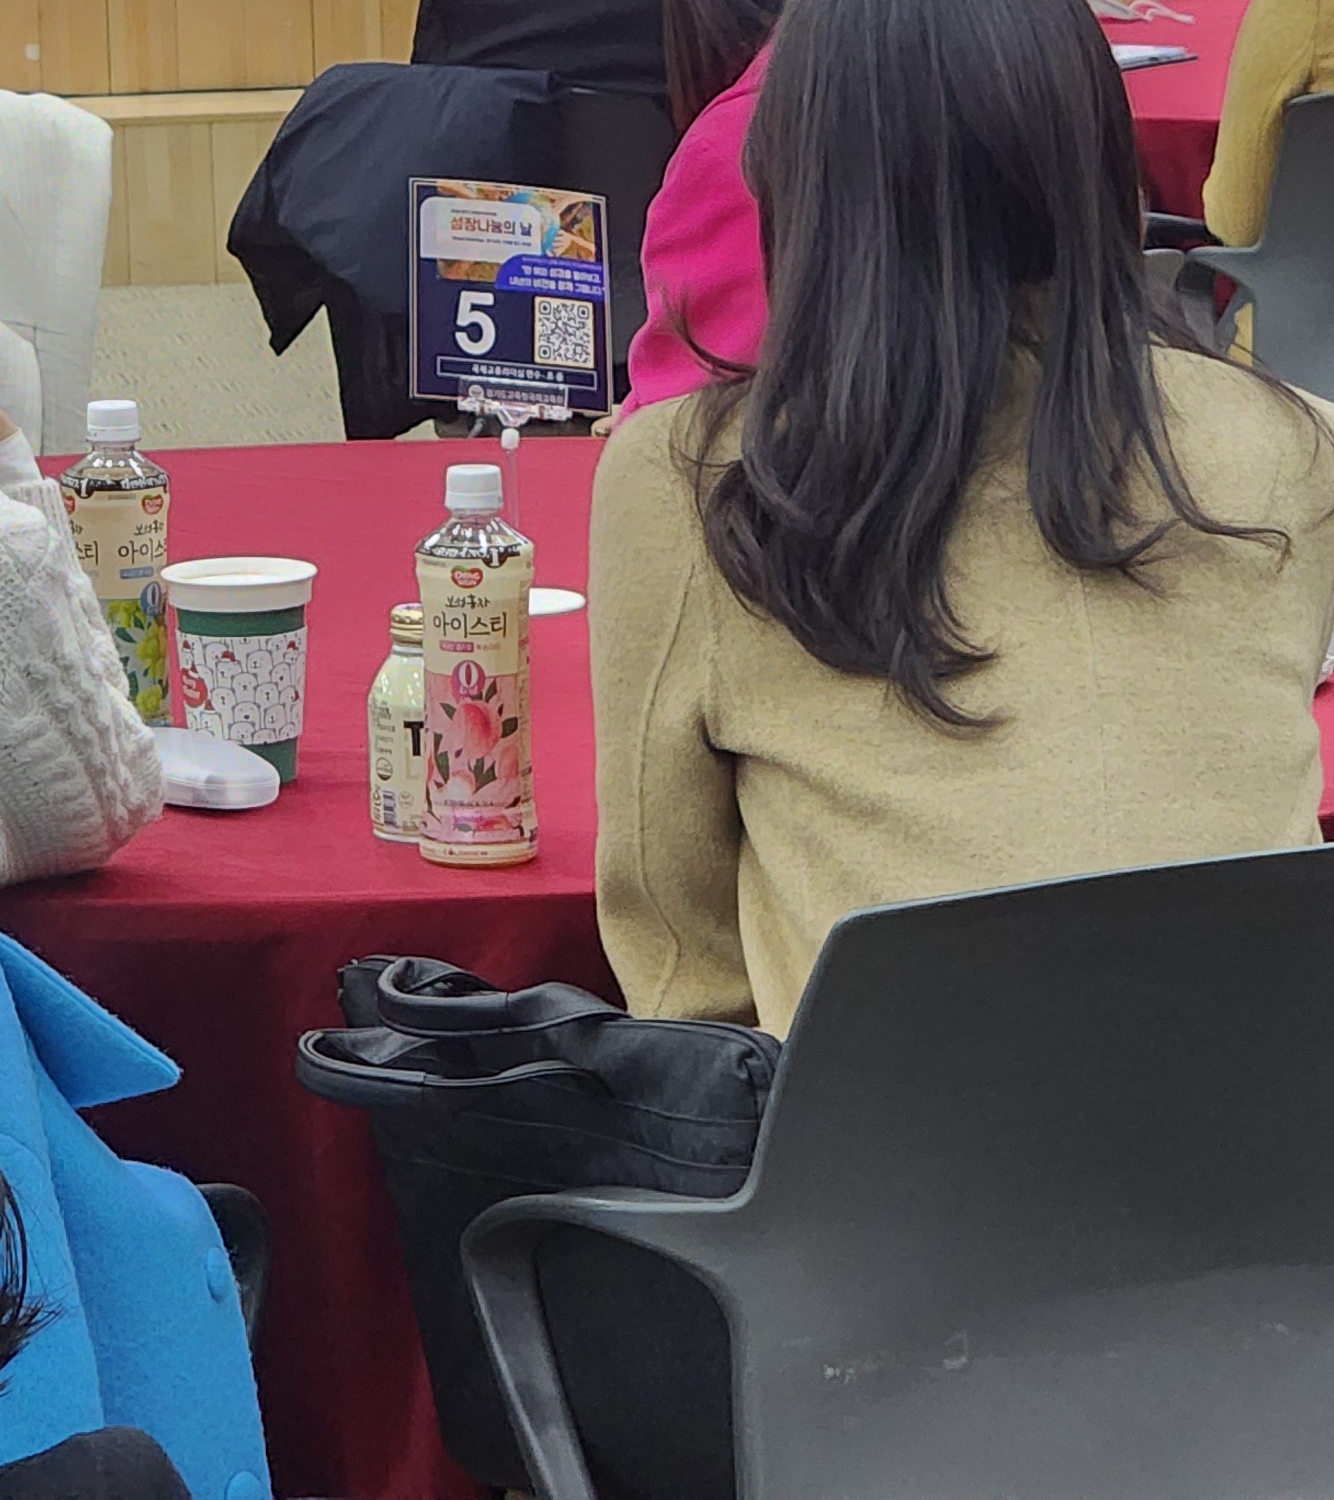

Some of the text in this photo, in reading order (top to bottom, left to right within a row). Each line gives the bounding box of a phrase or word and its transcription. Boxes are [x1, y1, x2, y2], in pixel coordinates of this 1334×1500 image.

[451, 216, 533, 237] 성장나눔의 날
[455, 290, 496, 356] 5
[118, 538, 167, 564] 아이스
[445, 594, 491, 609] 보성홍차
[433, 611, 507, 638] 아이스티
